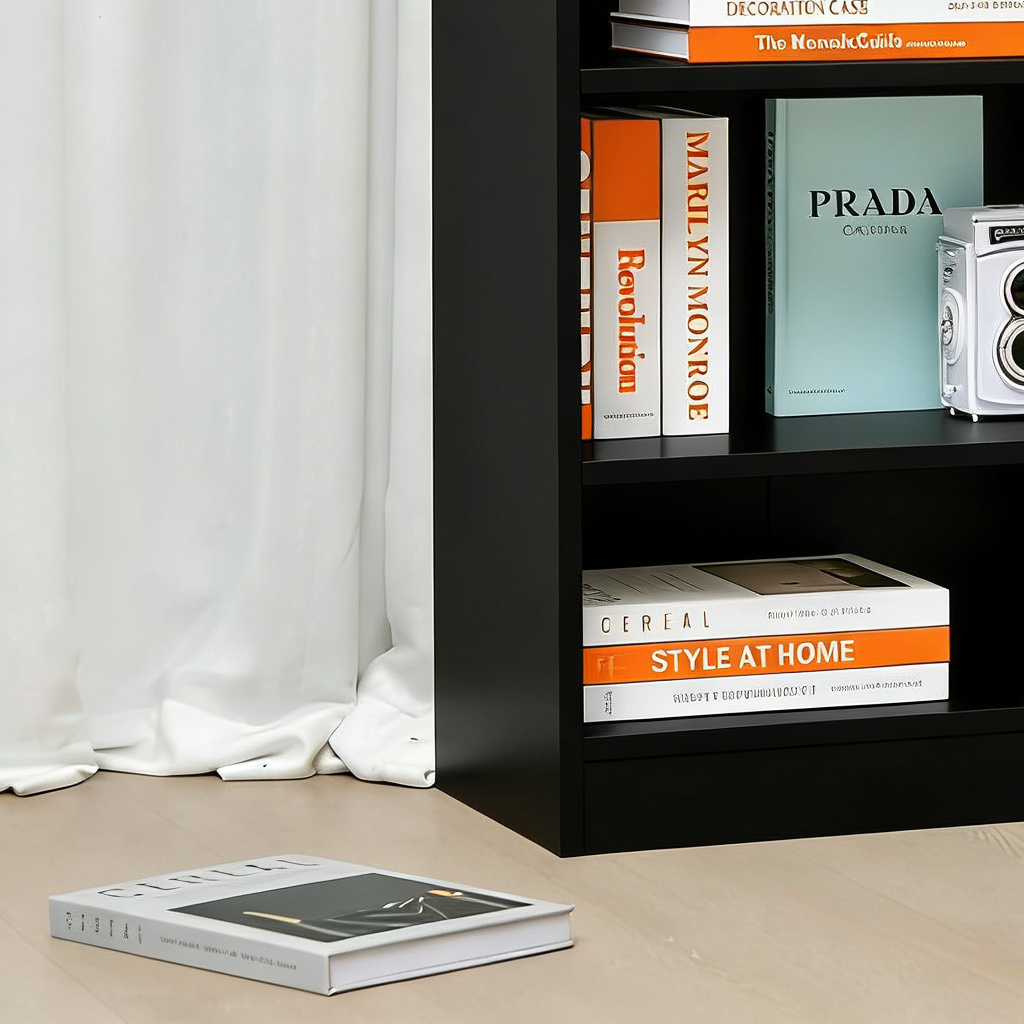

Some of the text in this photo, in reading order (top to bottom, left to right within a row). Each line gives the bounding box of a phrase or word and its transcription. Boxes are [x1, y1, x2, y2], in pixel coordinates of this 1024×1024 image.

[809, 187, 943, 218] PRADA
[686, 131, 710, 421] MARILYN MONROE
[651, 639, 855, 673] STYLE AT HOME
